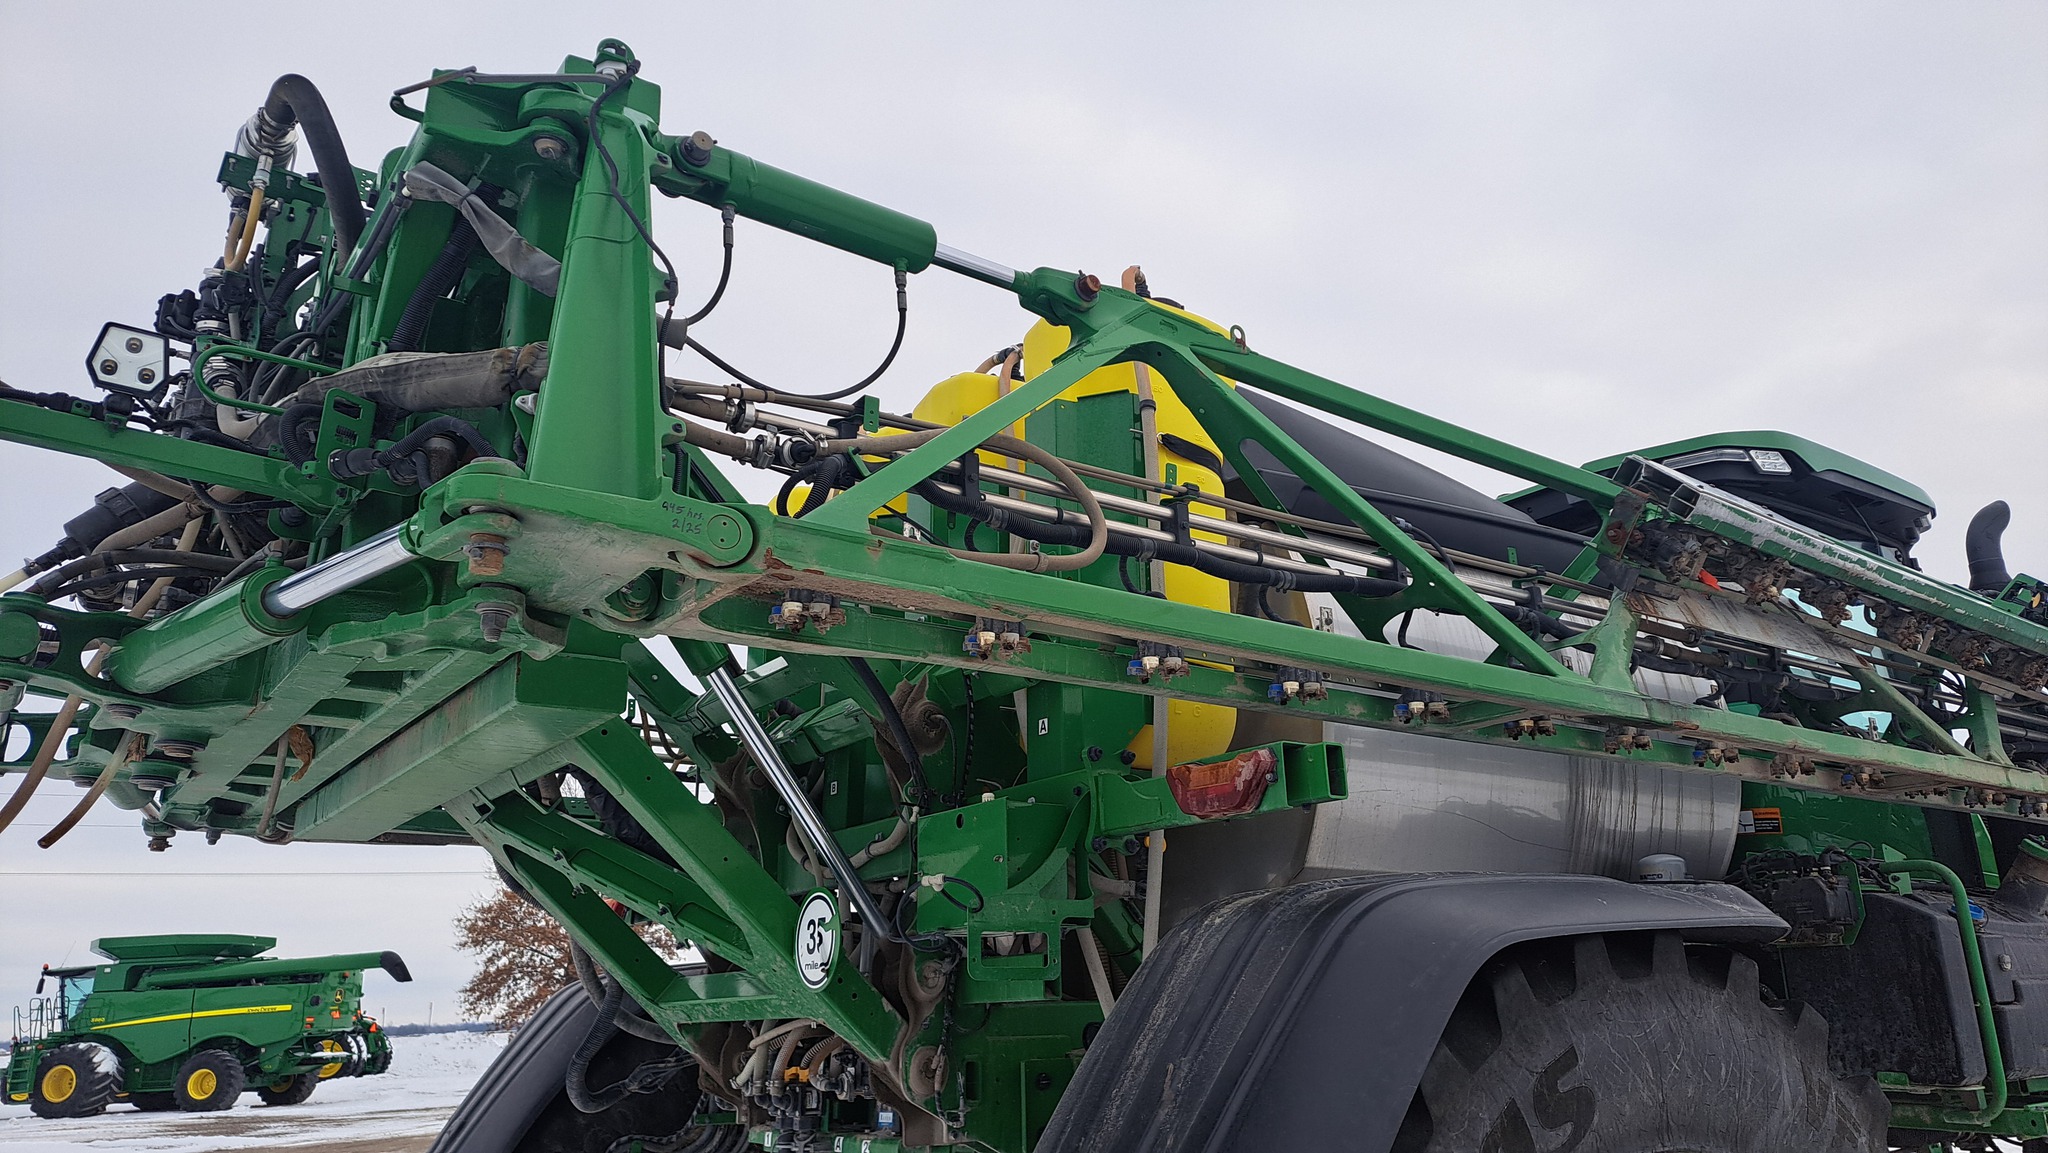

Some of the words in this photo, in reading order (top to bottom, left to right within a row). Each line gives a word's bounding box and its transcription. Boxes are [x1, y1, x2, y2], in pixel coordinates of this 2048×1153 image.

[661, 500, 685, 514] 945
[671, 517, 703, 535] 2/25
[1039, 719, 1047, 734] A
